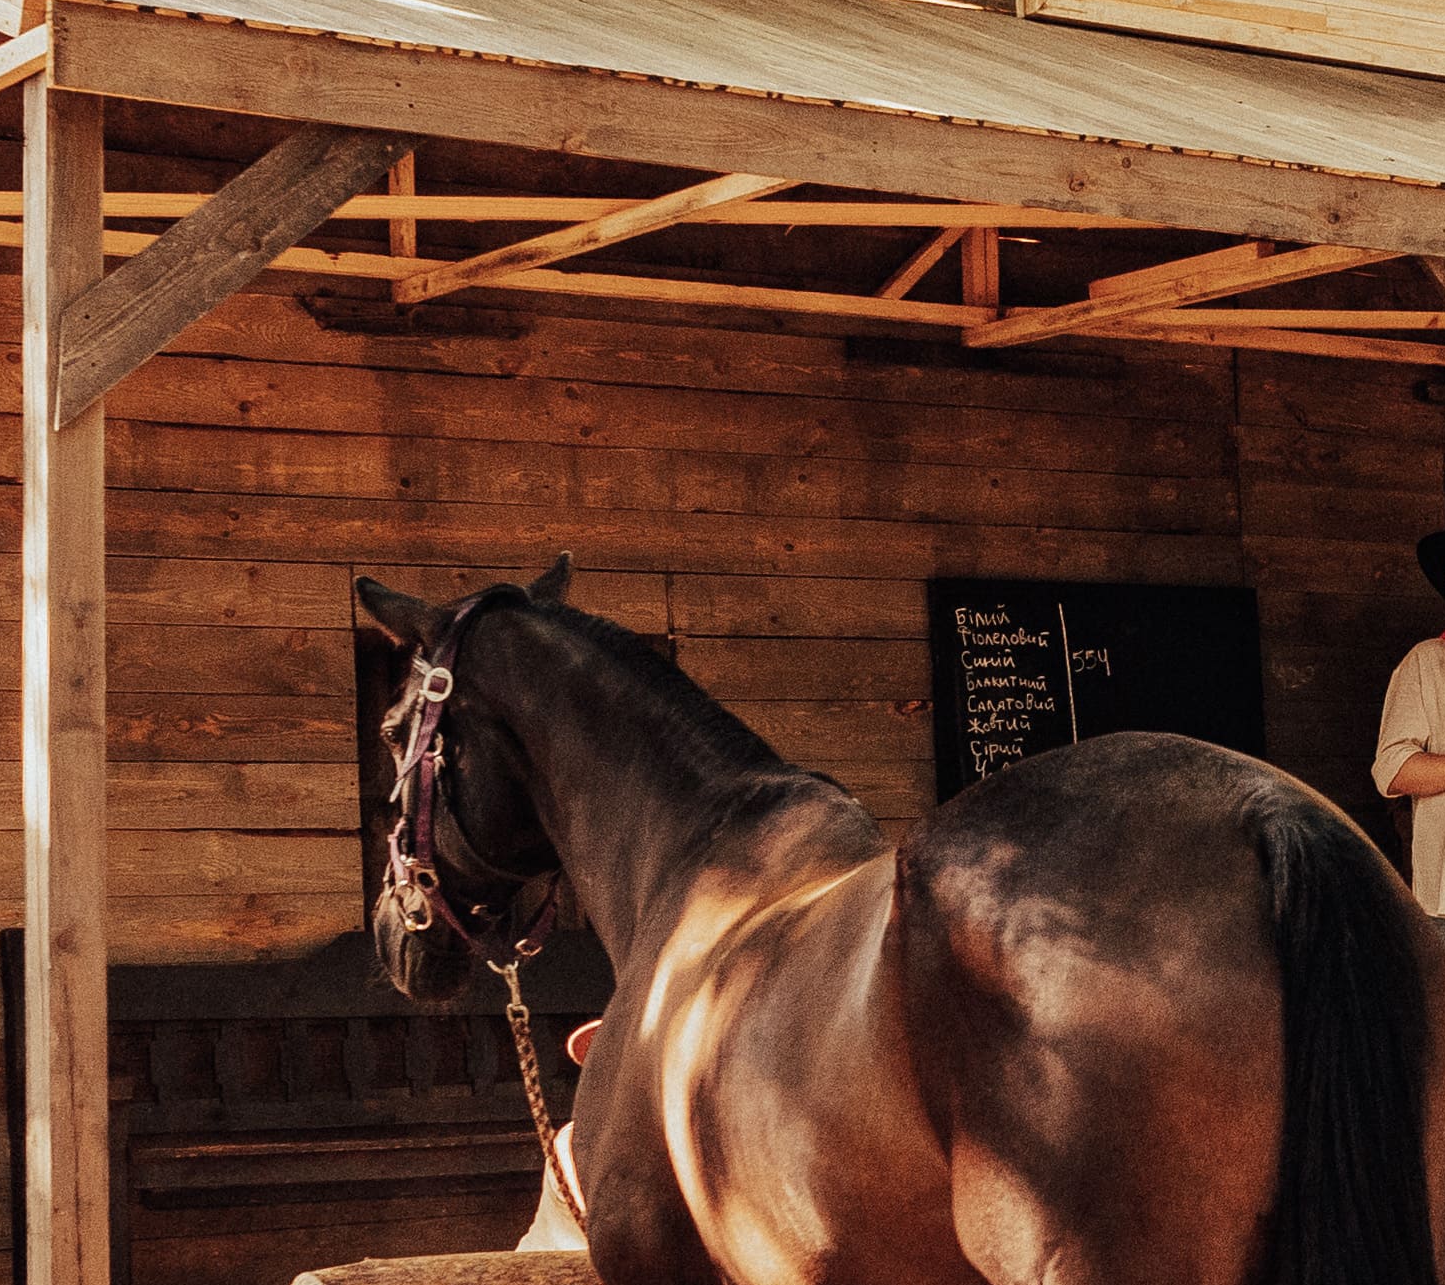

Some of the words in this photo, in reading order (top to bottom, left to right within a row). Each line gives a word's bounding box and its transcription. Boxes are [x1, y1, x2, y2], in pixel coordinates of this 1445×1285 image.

[955, 603, 1011, 628] Білий
[961, 648, 1016, 669] Синій
[965, 671, 1047, 692] Блакитний
[967, 693, 1055, 713] Салатовий
[970, 737, 1024, 763] Сірий
